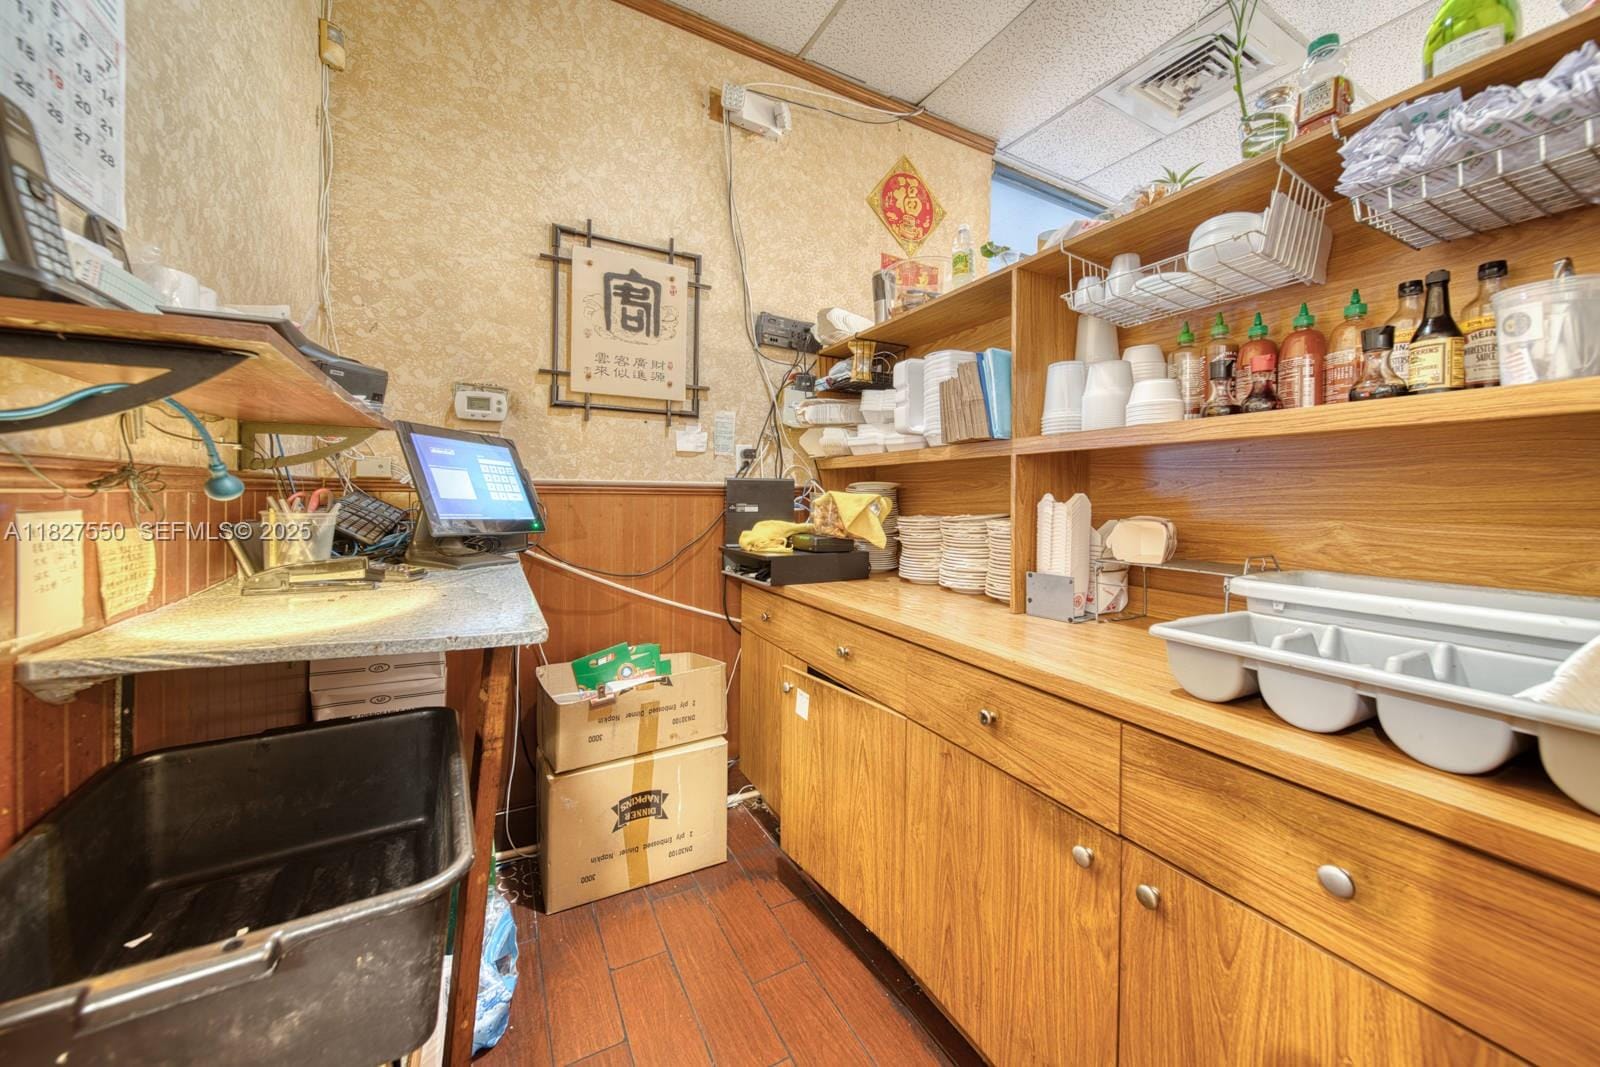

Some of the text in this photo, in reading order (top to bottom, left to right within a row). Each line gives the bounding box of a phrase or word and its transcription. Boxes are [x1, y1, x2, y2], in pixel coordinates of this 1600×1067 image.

[75, 94, 92, 115] 20
[100, 118, 114, 137] 21
[74, 127, 91, 146] 27
[100, 149, 115, 168] 28
[1471, 329, 1497, 341] HEIN
[648, 703, 677, 714] Embossed
[679, 700, 689, 709] ply
[597, 714, 621, 725] Napkin
[625, 709, 645, 720] Dinner
[620, 793, 661, 812] NAPKINS
[624, 806, 657, 821] DINNER
[675, 831, 686, 841] ply
[642, 836, 673, 849] Embossed
[619, 846, 639, 856] Dinner
[590, 852, 614, 864] Napkin
[580, 873, 597, 884] 3000
